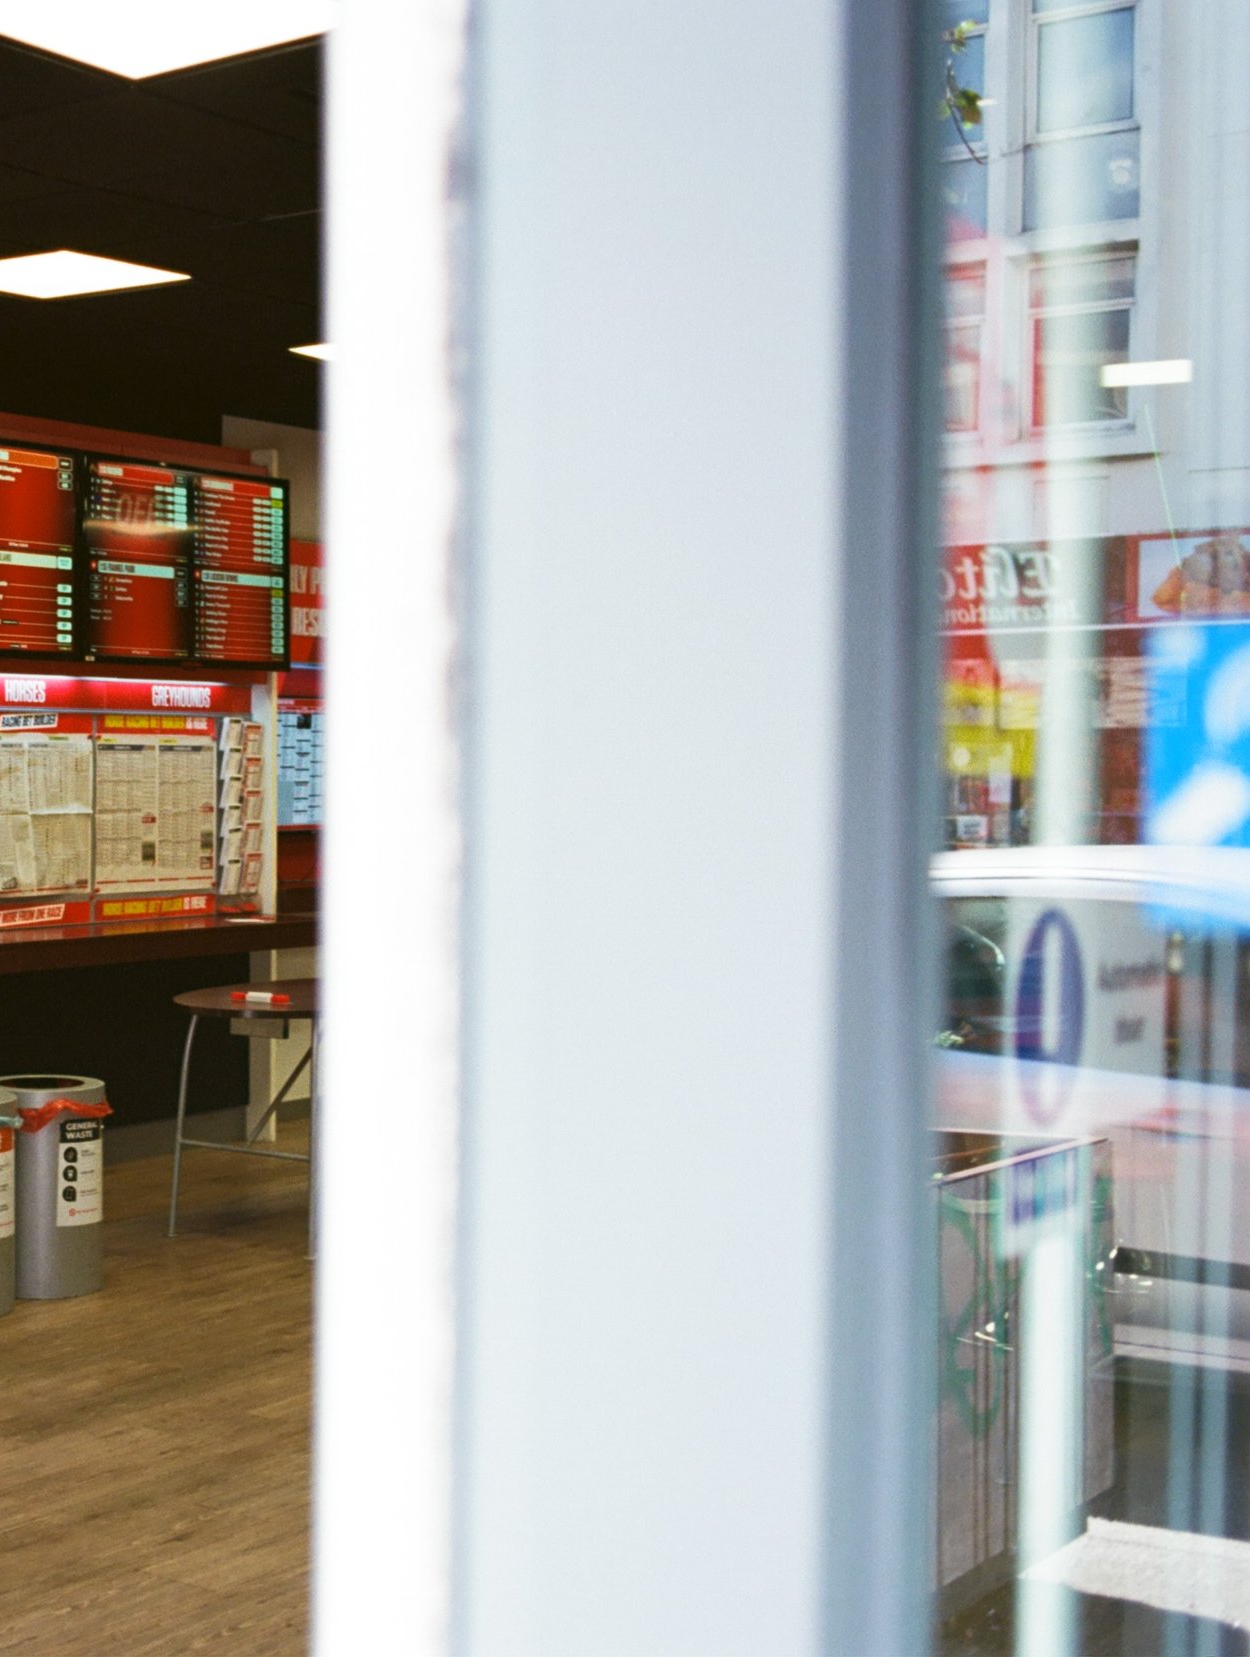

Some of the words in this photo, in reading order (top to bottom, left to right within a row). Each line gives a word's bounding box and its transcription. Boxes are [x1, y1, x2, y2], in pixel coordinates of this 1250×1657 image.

[4, 679, 46, 703] HORSES
[151, 684, 212, 708] GREYHOUNDS
[65, 1120, 99, 1131] GENERAL
[65, 1130, 93, 1140] WASTE
